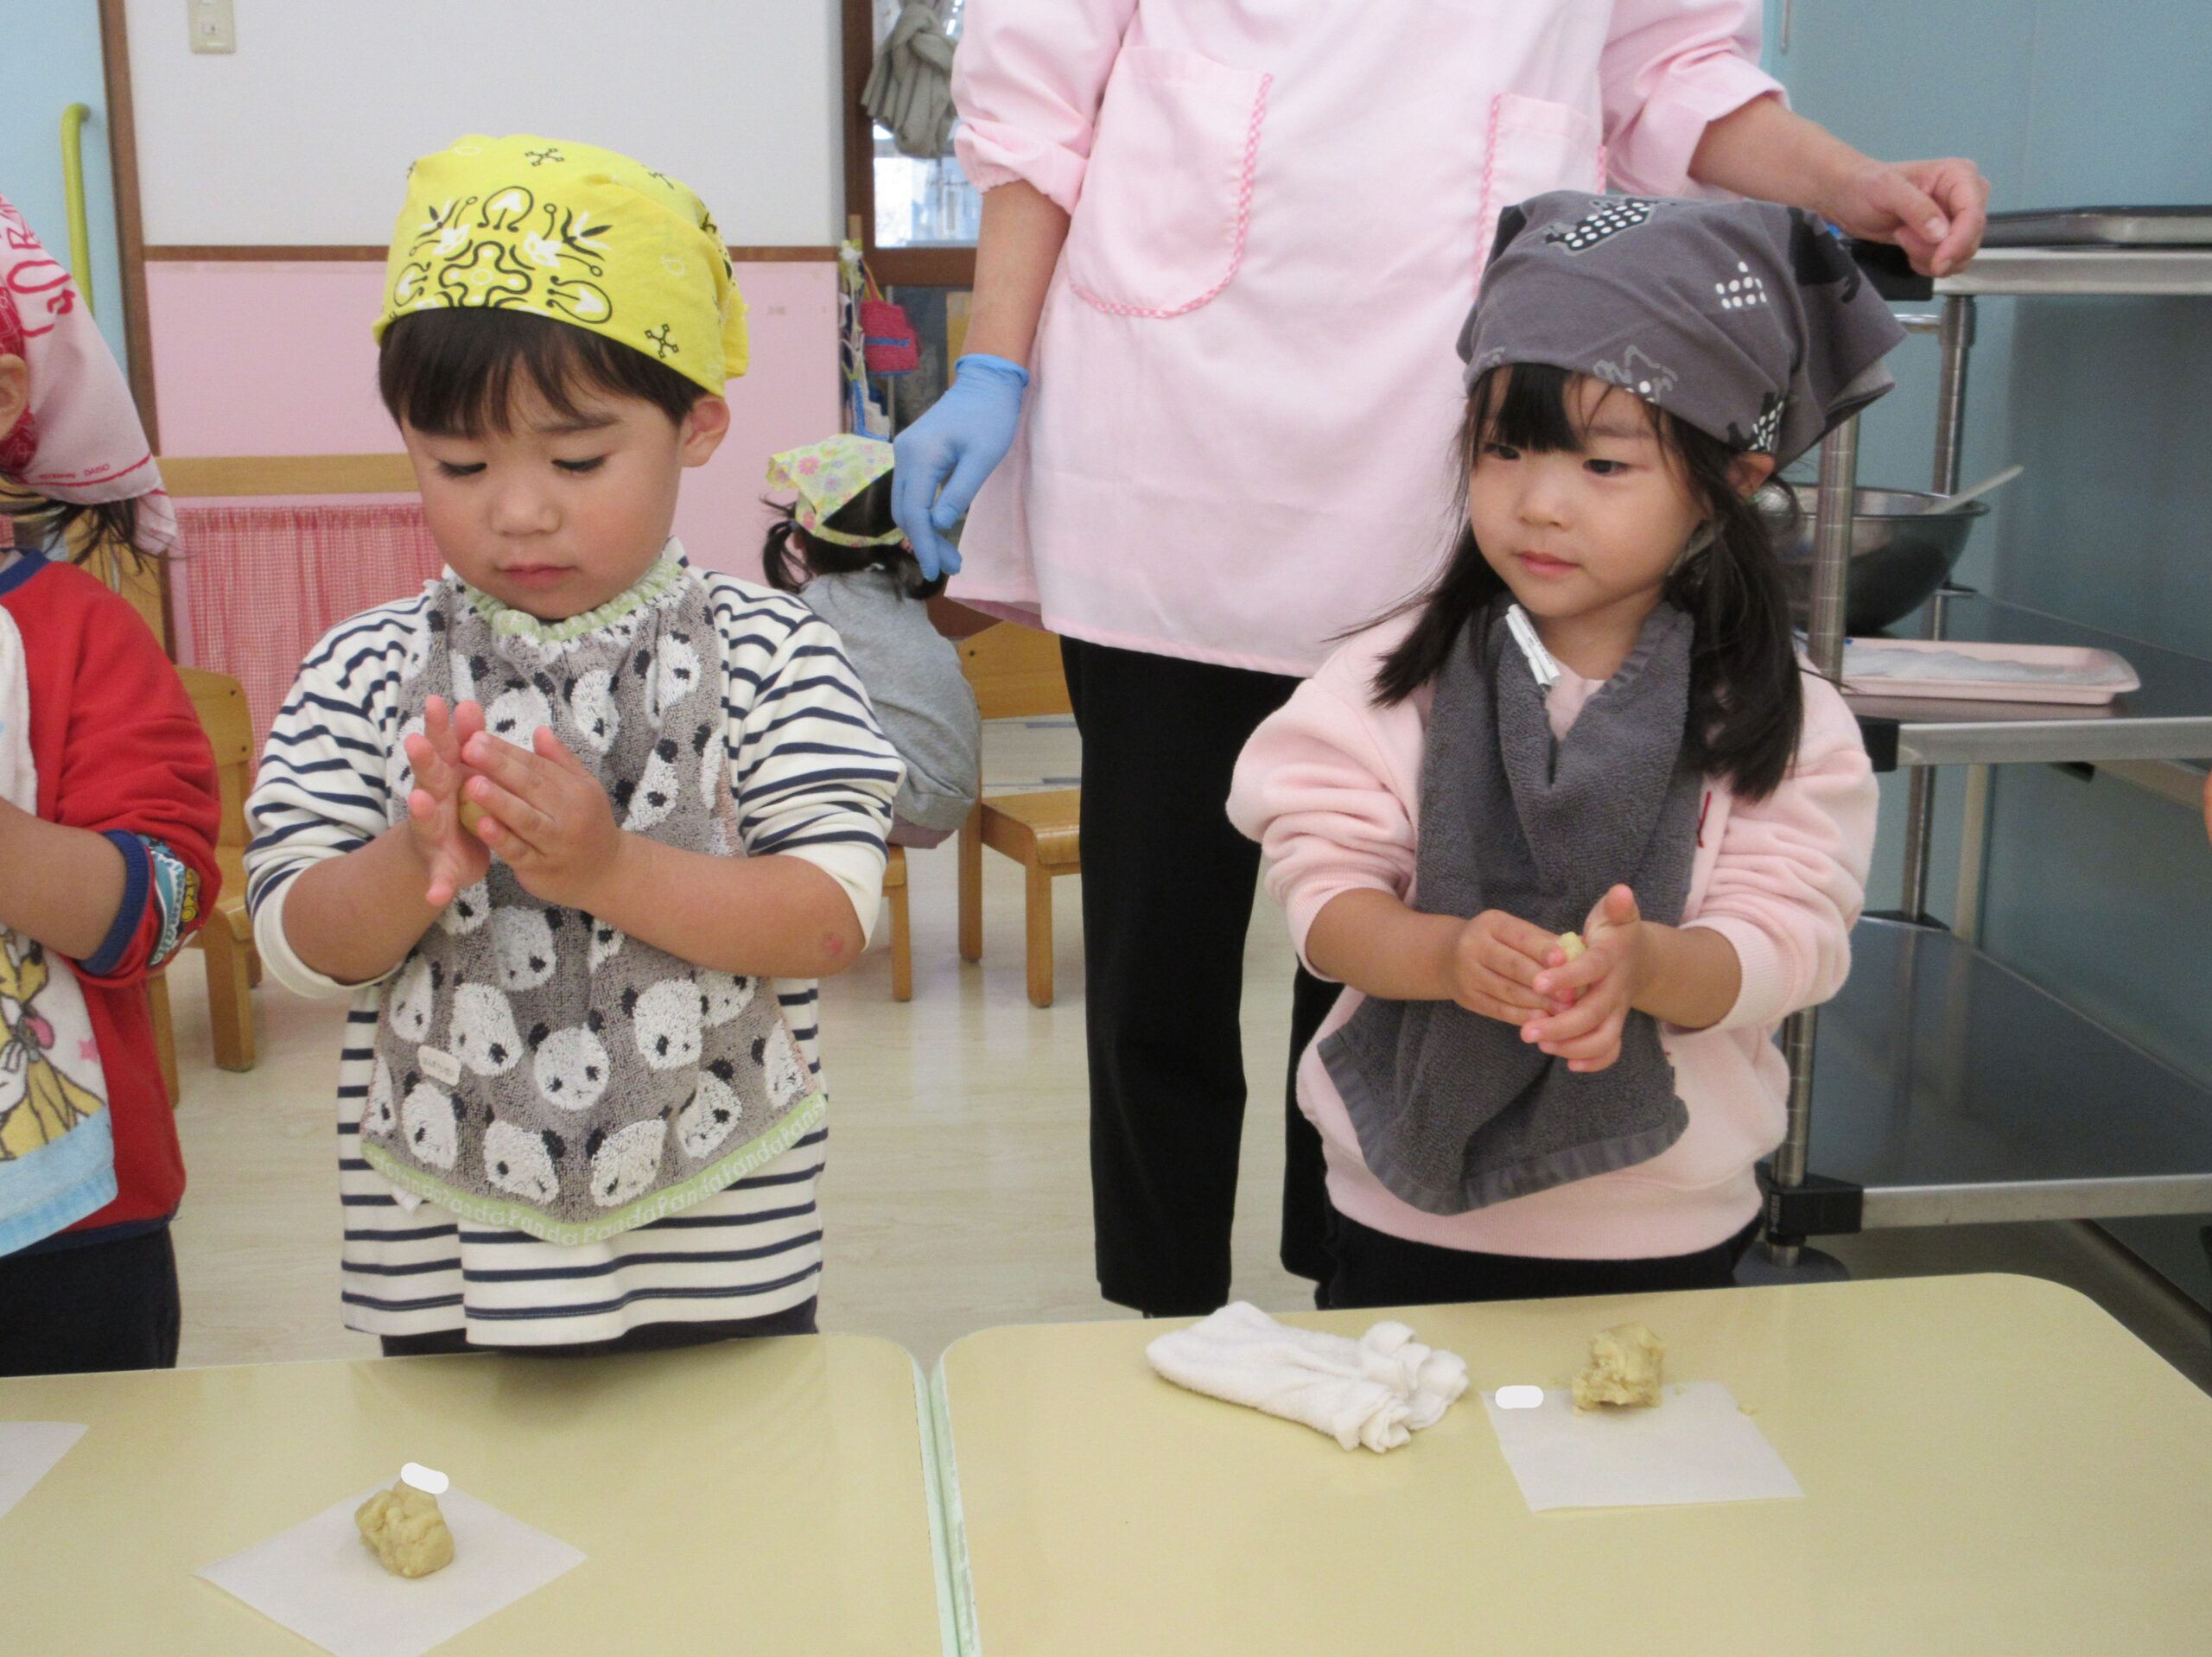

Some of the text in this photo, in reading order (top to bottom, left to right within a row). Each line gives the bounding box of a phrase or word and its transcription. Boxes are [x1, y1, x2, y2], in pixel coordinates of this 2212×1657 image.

[84, 463, 111, 476] DAISO
[582, 1206, 658, 1243] Panda
[658, 1175, 723, 1217] Panda
[722, 1137, 784, 1184] Panda
